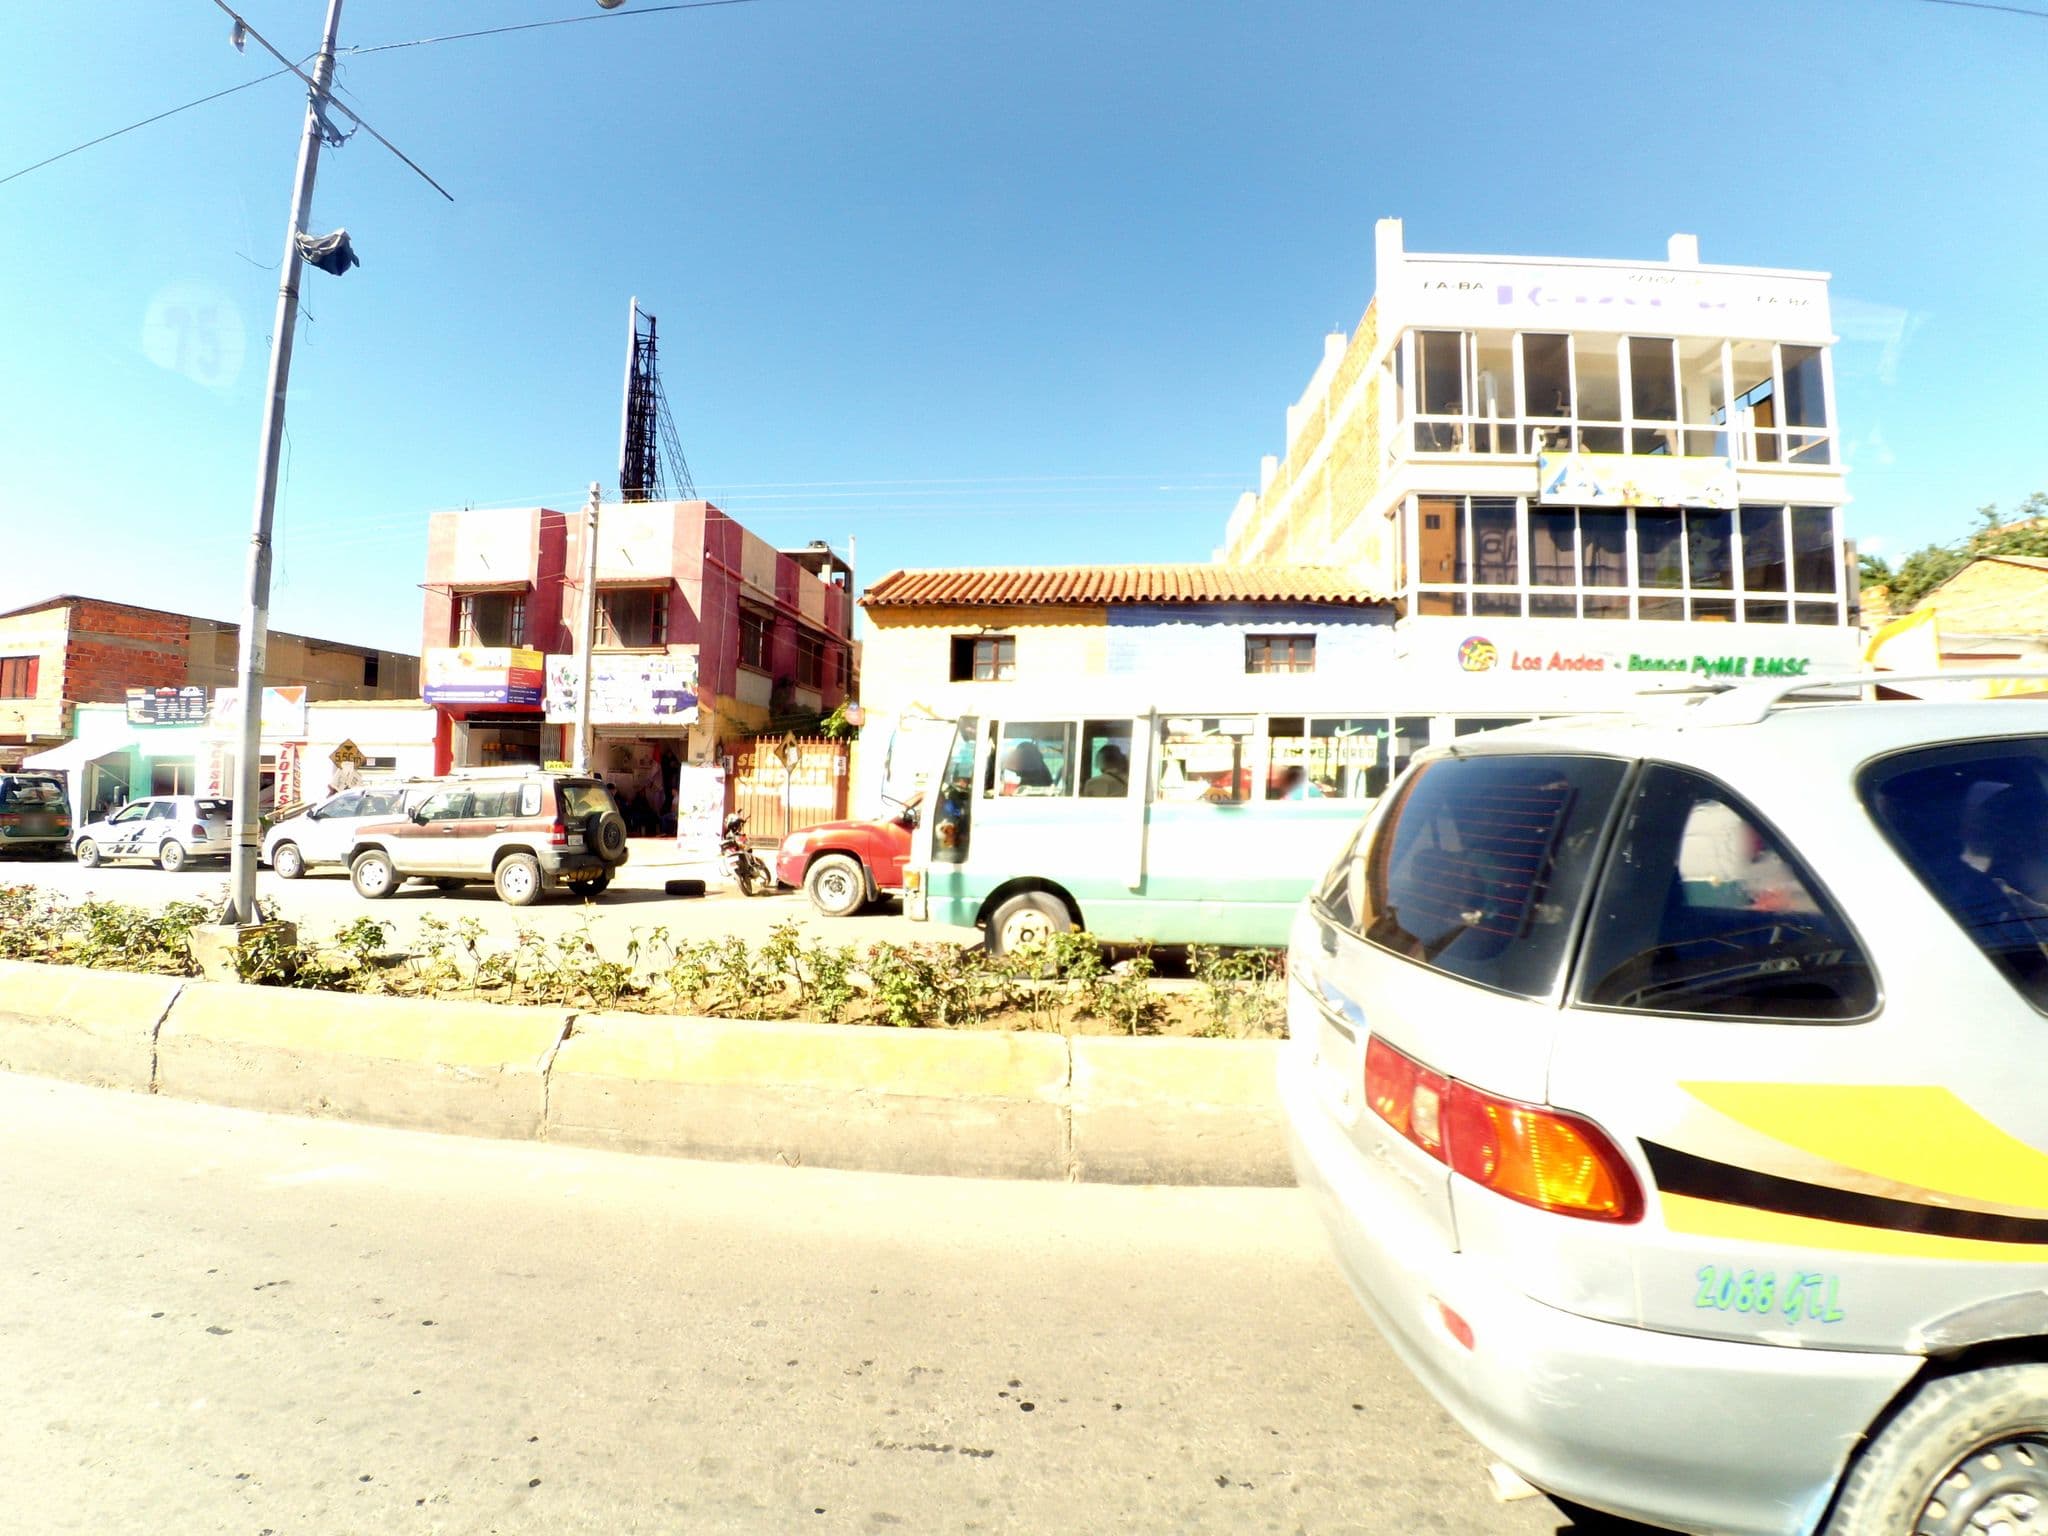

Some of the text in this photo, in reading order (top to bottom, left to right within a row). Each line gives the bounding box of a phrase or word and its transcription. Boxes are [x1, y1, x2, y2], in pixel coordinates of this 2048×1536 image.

[1511, 649, 1542, 671] Los
[1547, 650, 1605, 672] Andes
[276, 749, 292, 806] LOTES
